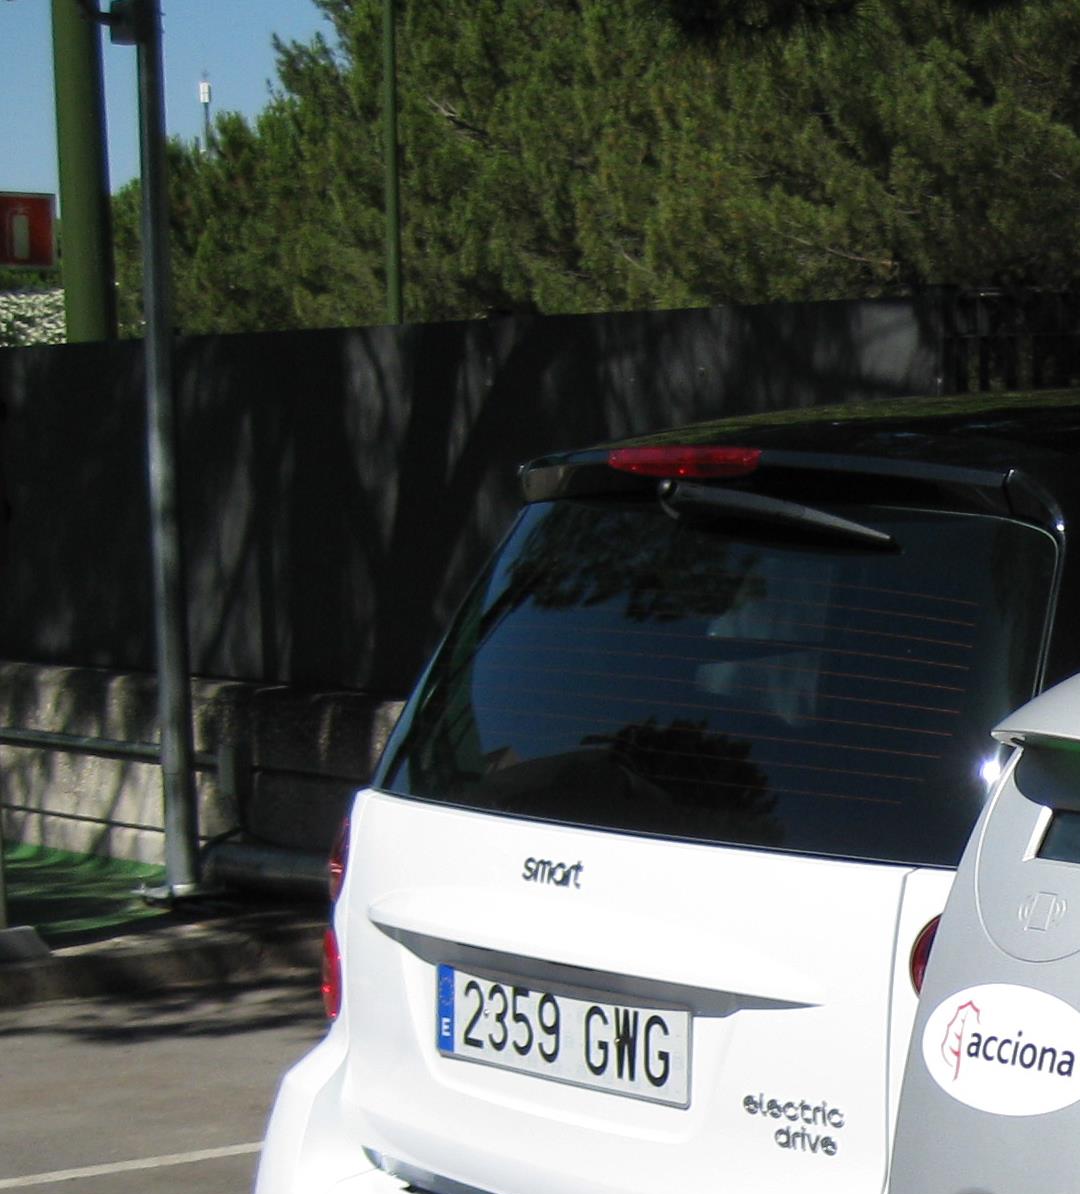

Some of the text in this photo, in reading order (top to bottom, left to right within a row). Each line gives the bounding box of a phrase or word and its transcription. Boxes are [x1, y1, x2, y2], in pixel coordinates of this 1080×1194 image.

[522, 856, 583, 889] smart
[463, 980, 670, 1087] 2359 GWG
[966, 1030, 1076, 1078] acciona
[743, 1094, 845, 1129] electric
[775, 1126, 837, 1156] drive
